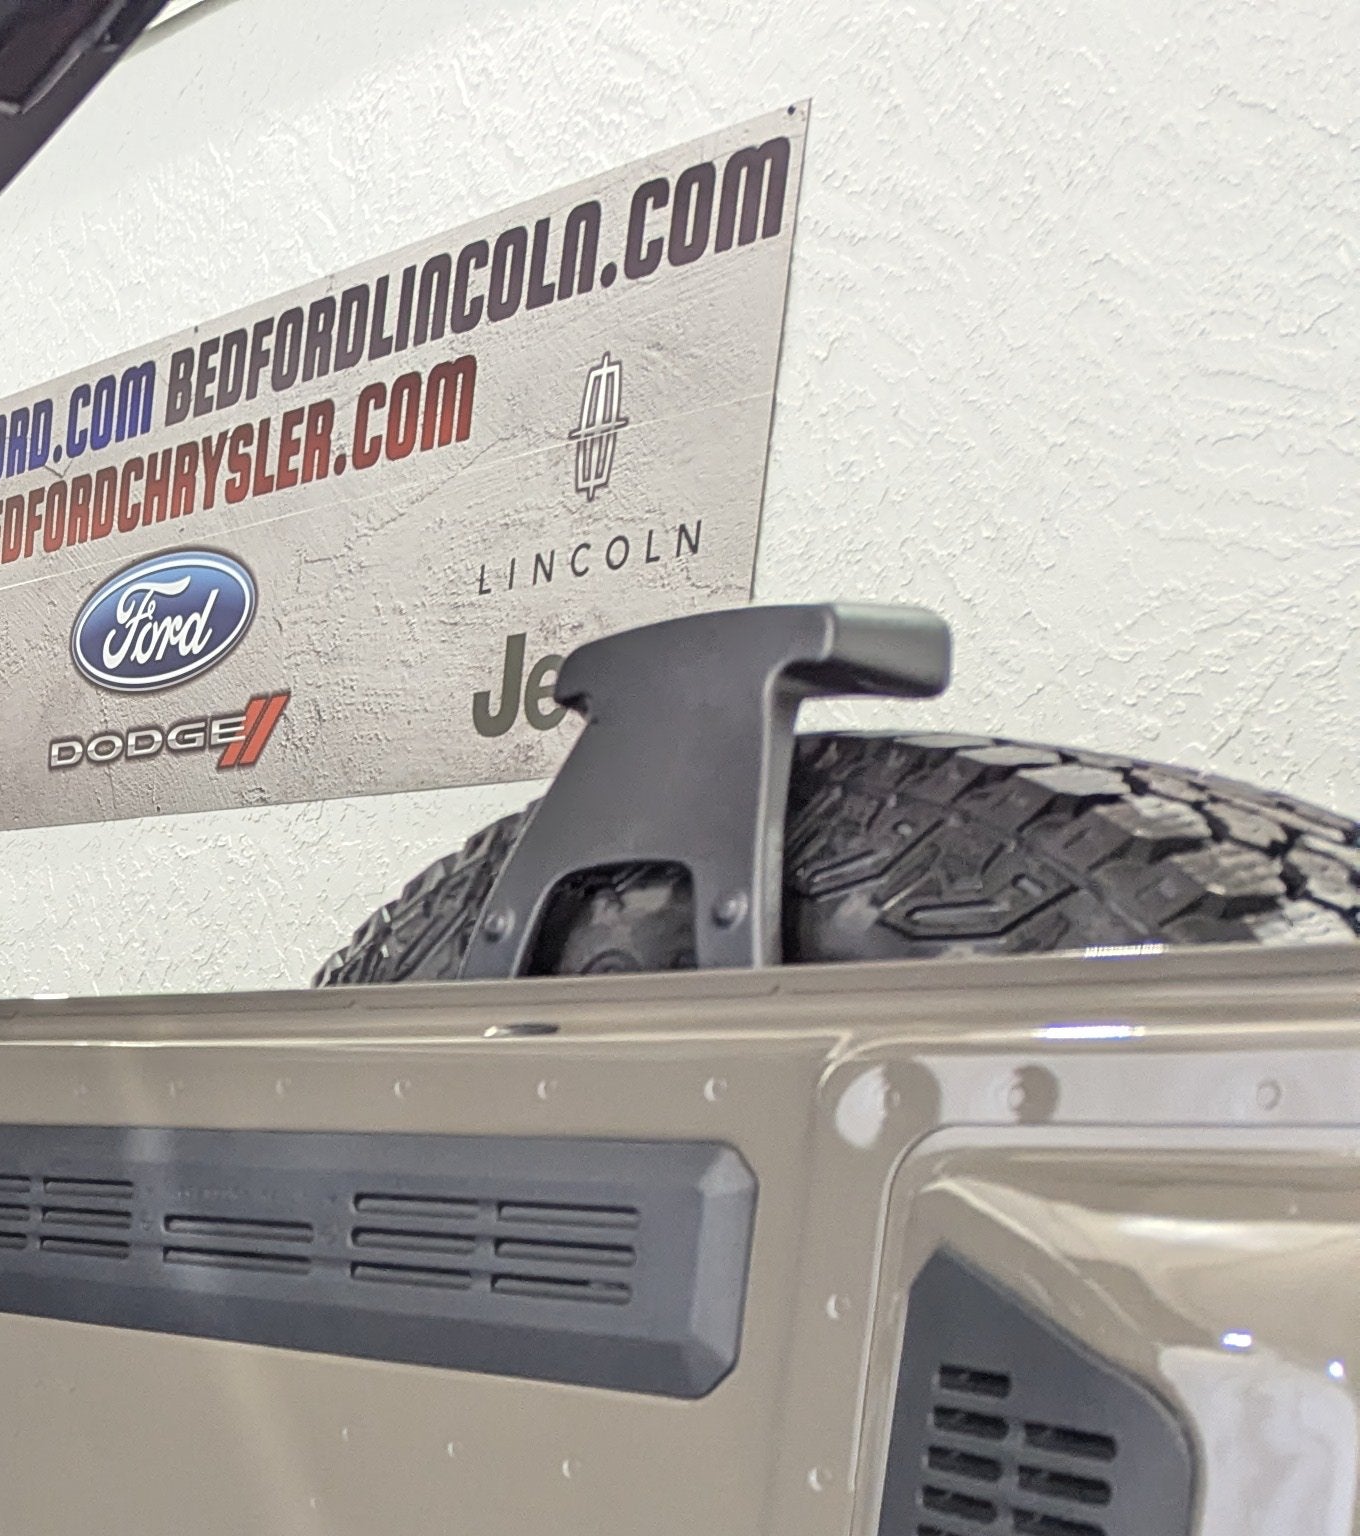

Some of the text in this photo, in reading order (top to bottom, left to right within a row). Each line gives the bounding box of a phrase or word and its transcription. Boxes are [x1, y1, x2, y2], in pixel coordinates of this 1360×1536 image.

[165, 136, 791, 428] BEDFORDLINCOLN.COM
[478, 519, 702, 596] LINCOLN
[102, 575, 220, 670] Ford
[472, 632, 568, 738] Je
[49, 714, 248, 768] DODGE
